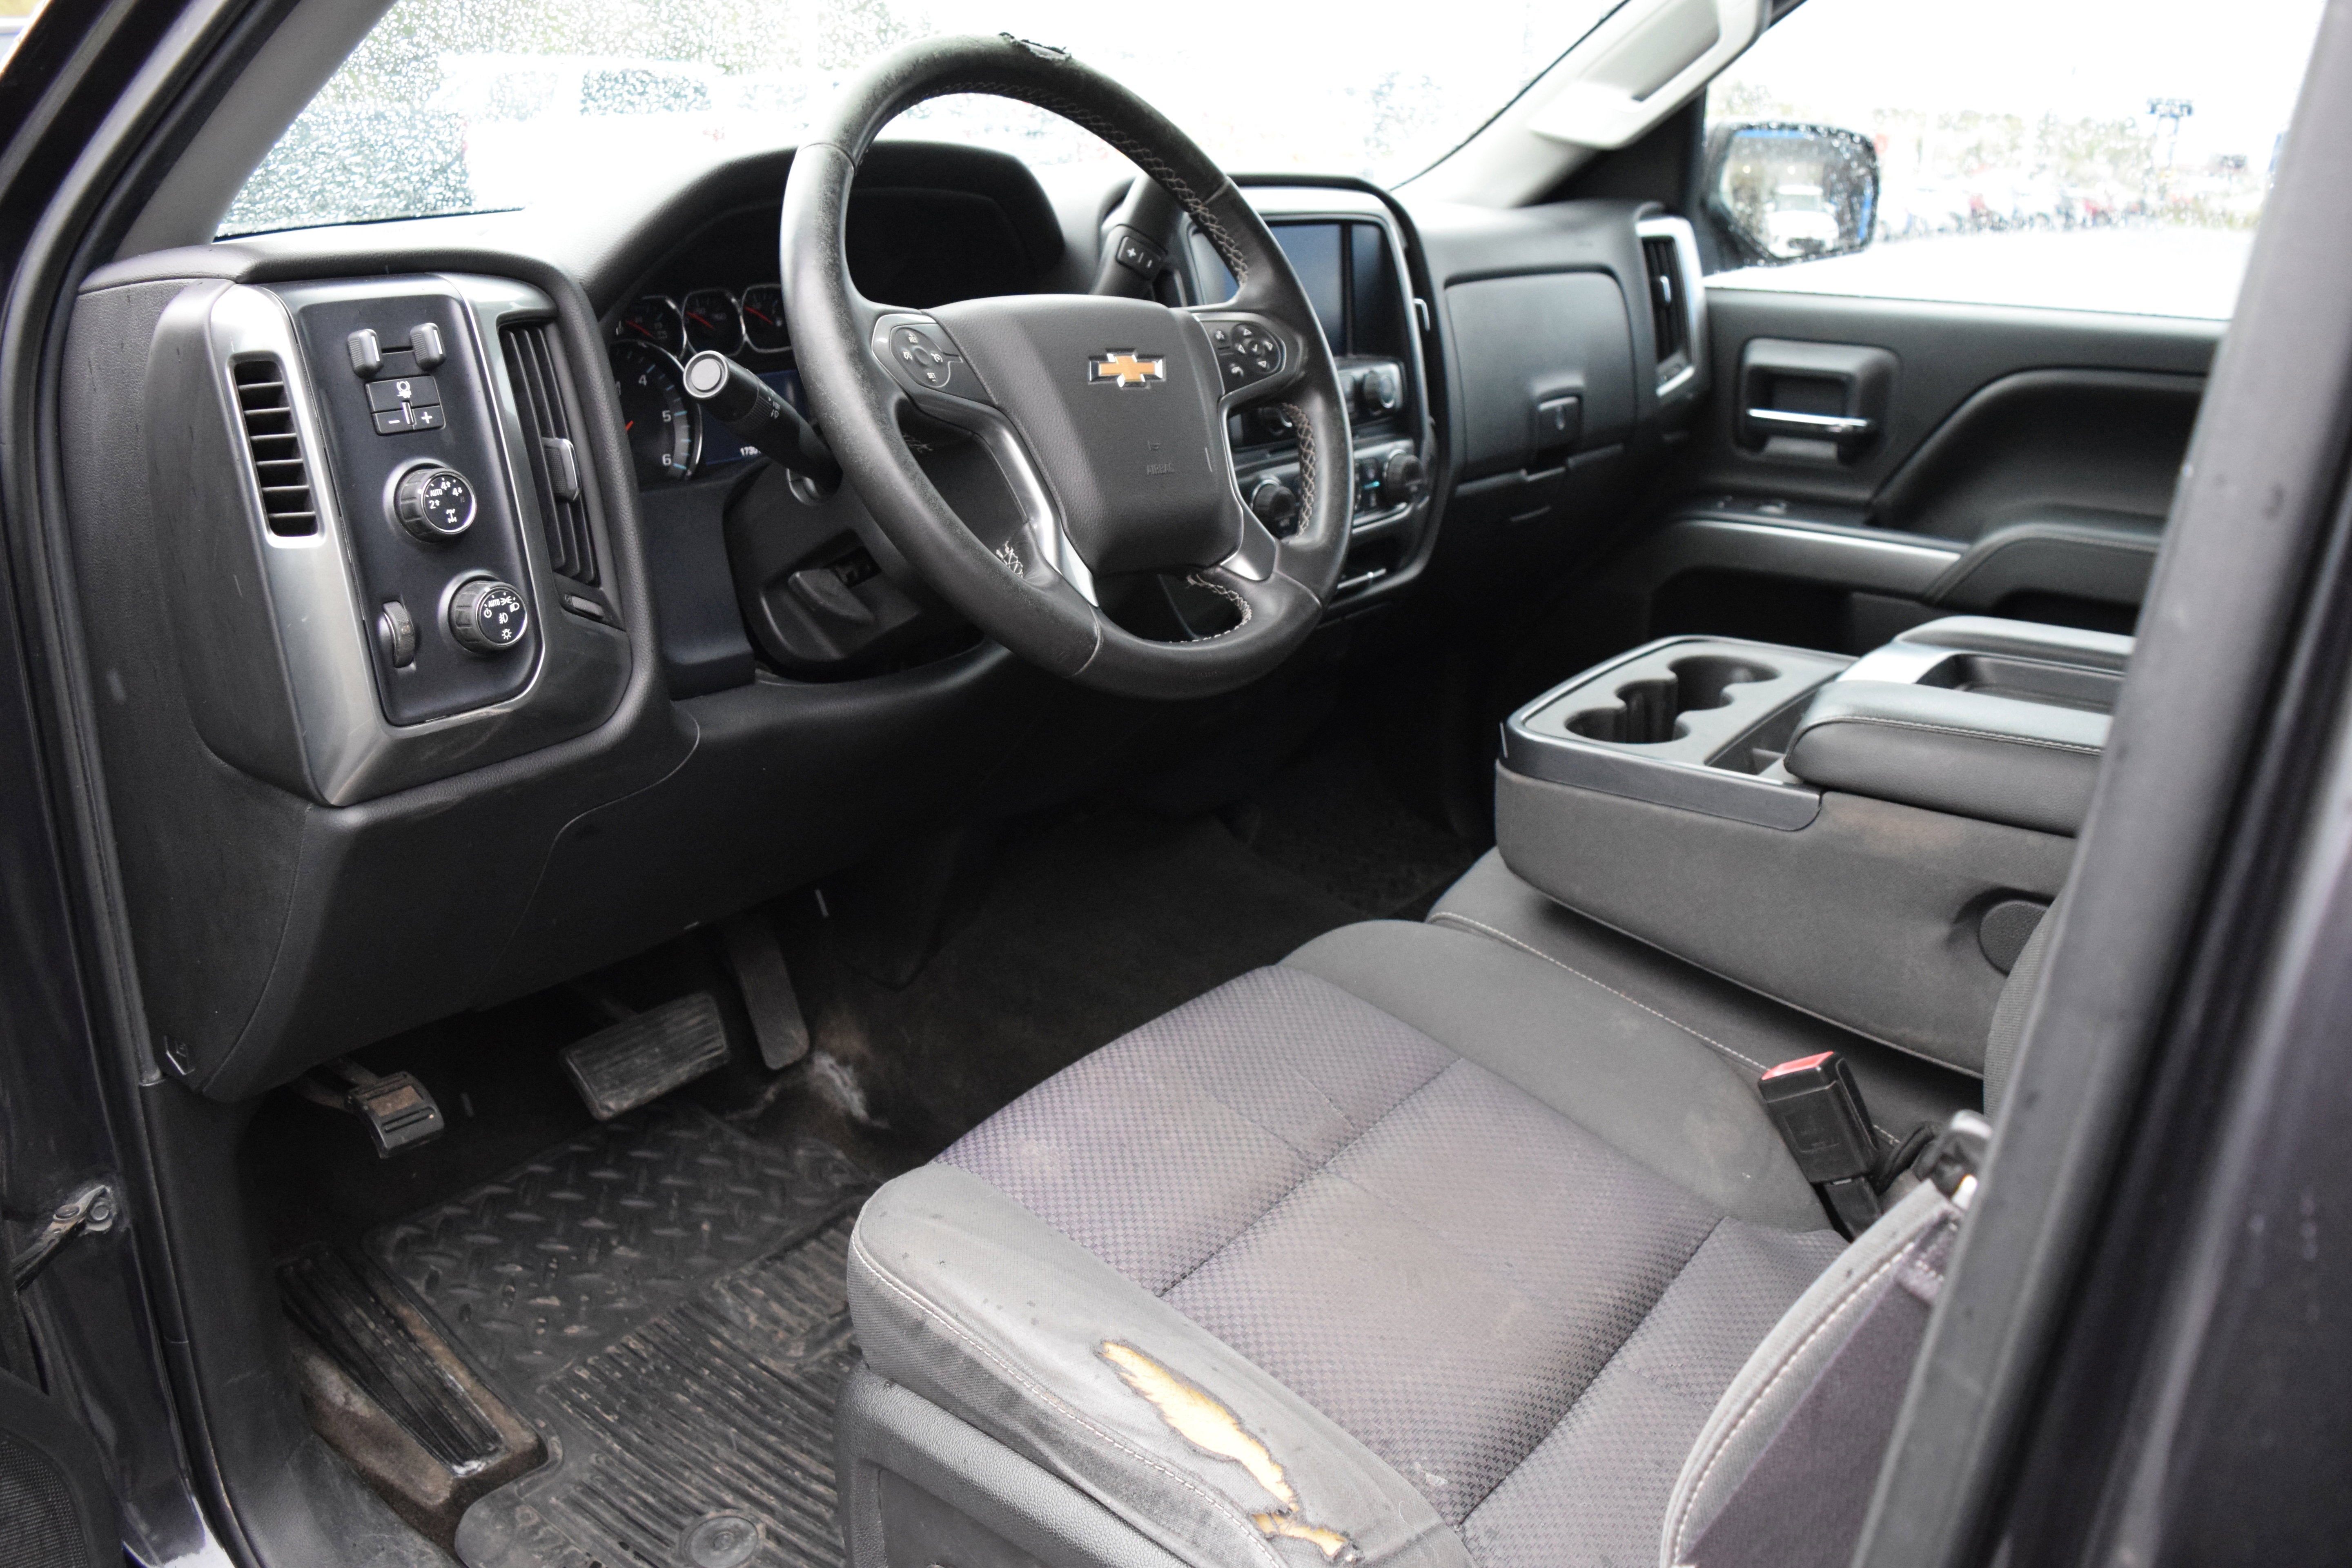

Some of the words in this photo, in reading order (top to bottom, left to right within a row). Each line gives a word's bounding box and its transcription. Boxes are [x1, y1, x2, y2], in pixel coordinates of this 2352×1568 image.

[638, 374, 647, 386] 4
[662, 410, 671, 422] 5
[662, 454, 671, 466] 6
[430, 488, 443, 497] AUTO
[488, 599, 500, 608] AUTO
